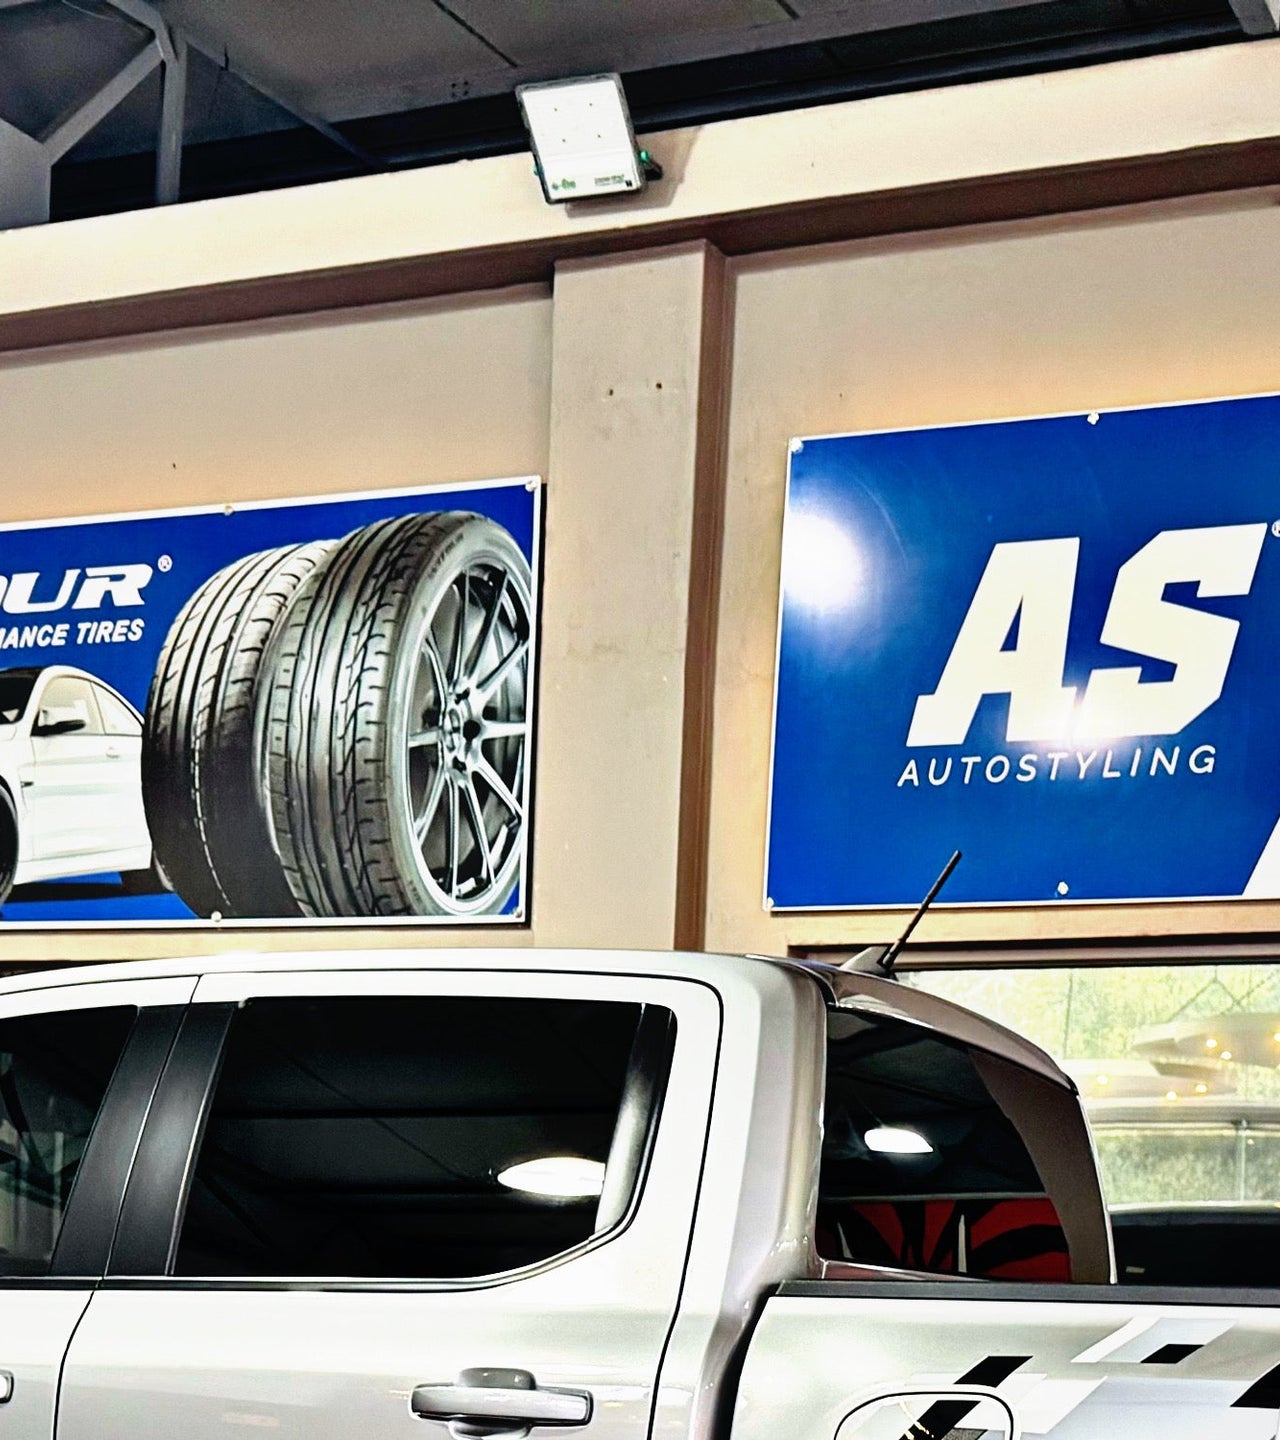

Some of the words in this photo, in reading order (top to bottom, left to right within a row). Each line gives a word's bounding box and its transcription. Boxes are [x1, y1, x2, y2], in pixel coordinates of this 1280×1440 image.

[76, 618, 145, 645] TIRES
[906, 522, 1268, 748] AS
[896, 744, 1216, 788] AUTOSTYLING
